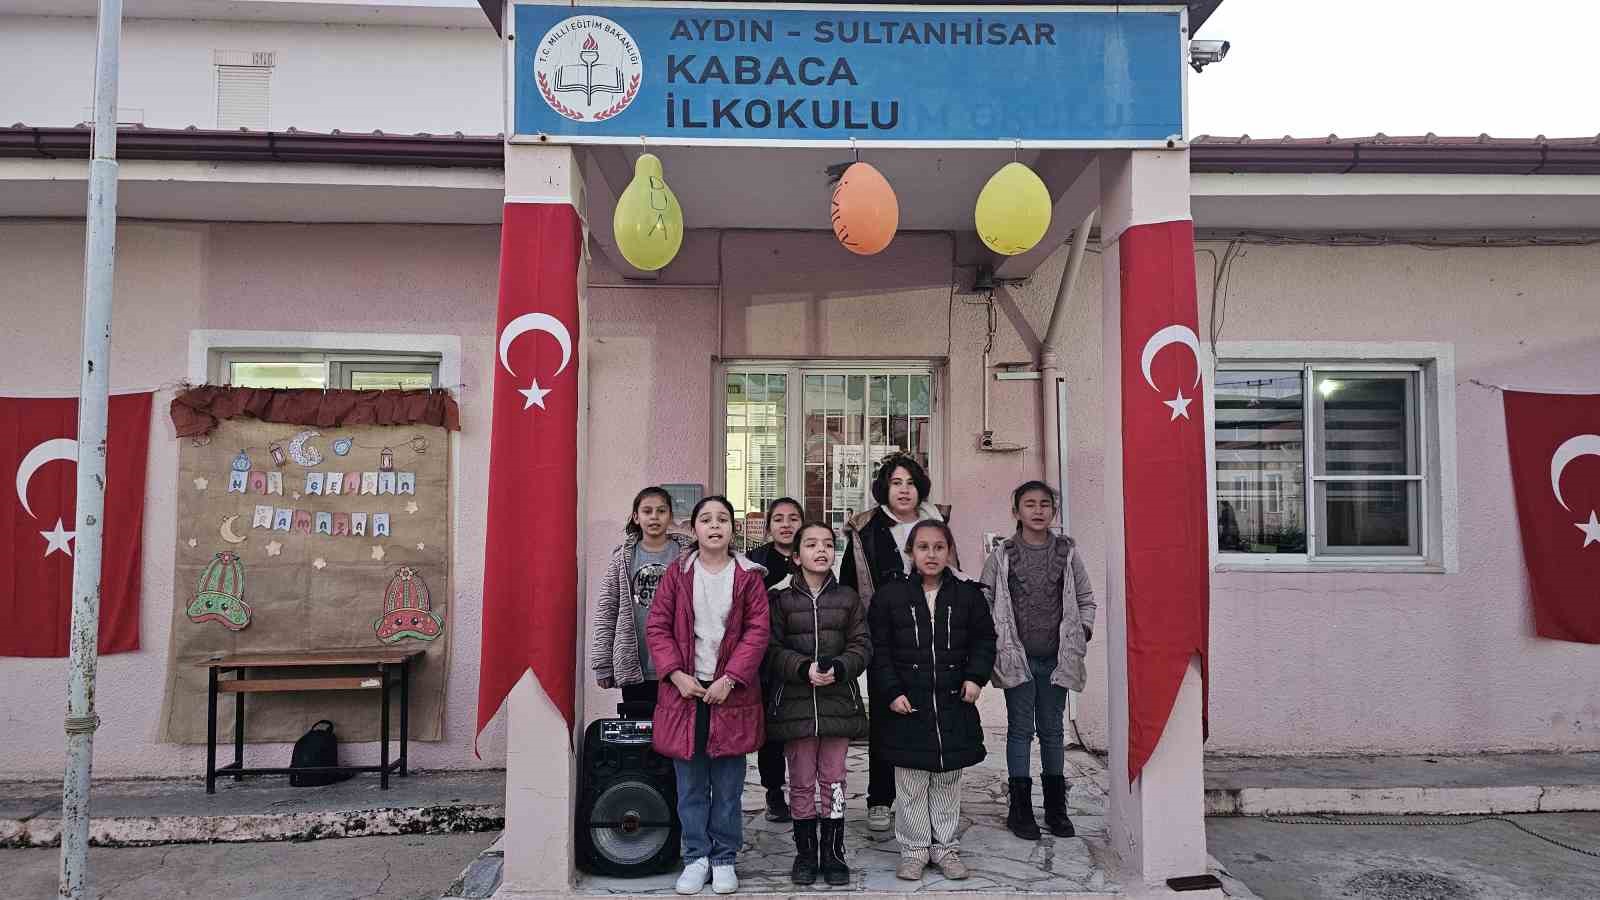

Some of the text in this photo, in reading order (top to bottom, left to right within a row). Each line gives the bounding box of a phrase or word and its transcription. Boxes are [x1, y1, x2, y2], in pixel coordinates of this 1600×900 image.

[670, 18, 773, 42] AYDIN
[814, 17, 1057, 46] SULTANHİSAR
[667, 54, 858, 87] KABACA
[667, 92, 899, 129] İLKOKULU
